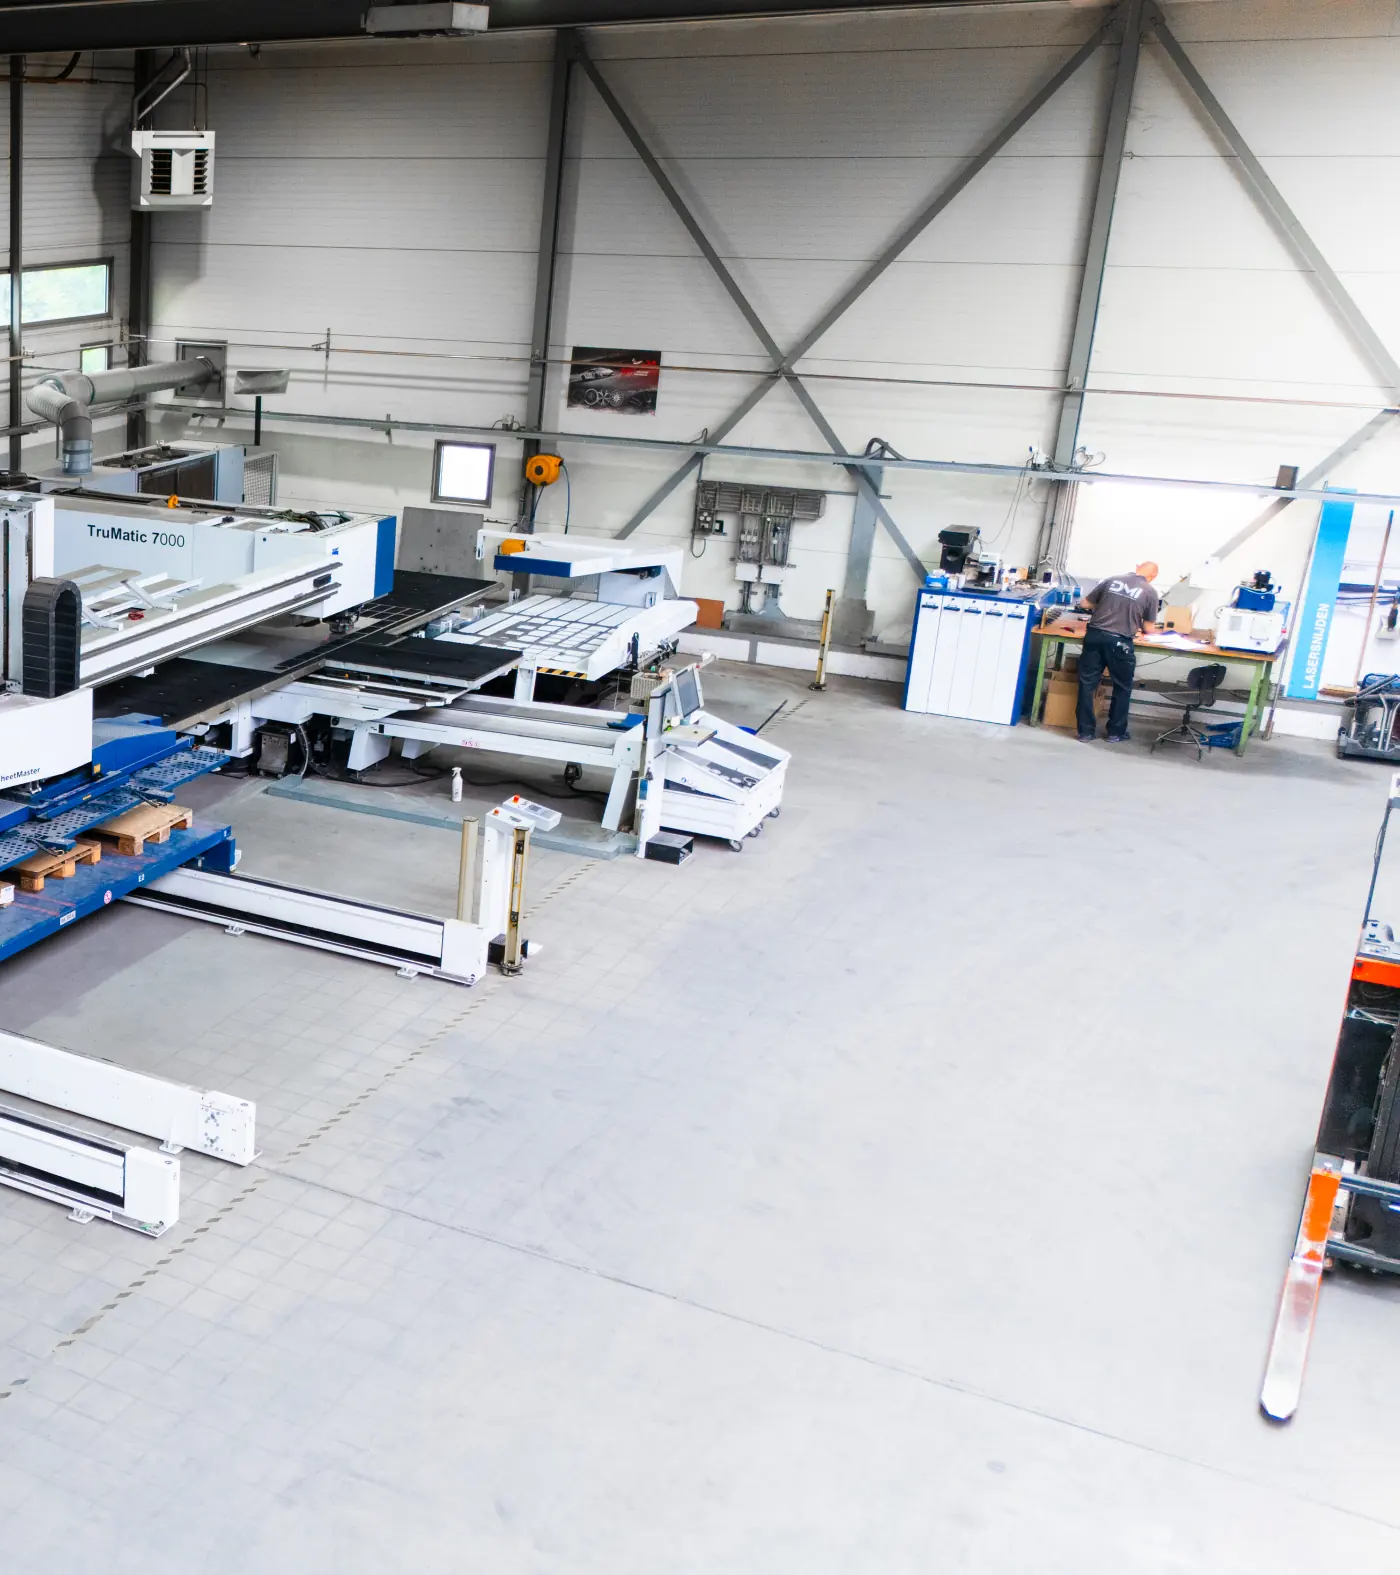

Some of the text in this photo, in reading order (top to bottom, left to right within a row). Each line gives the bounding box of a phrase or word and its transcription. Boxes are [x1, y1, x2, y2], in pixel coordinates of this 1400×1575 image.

[87, 524, 185, 548] TruMatic 7000
[1303, 603, 1330, 689] LASERSNIJDEN
